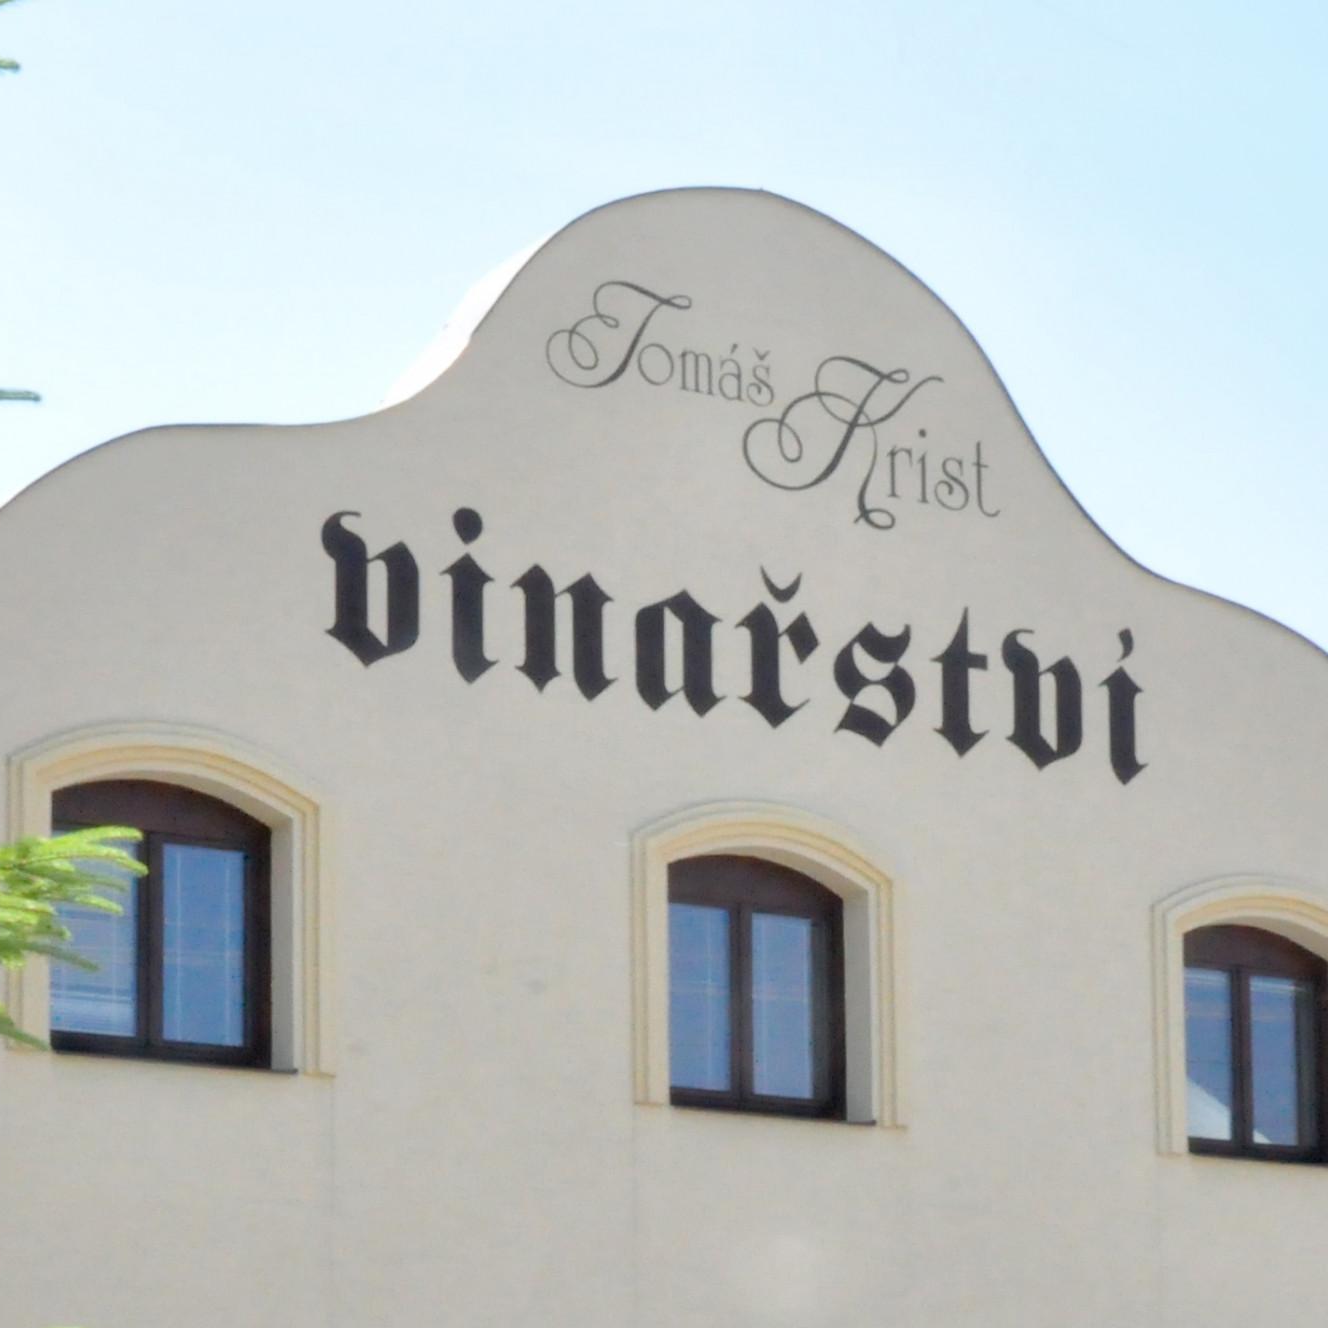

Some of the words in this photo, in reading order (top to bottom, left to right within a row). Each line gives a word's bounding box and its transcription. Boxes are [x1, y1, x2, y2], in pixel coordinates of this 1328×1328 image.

[545, 280, 776, 408] Tomáš
[742, 354, 1002, 531] Krist
[320, 507, 1150, 787] vinařství
